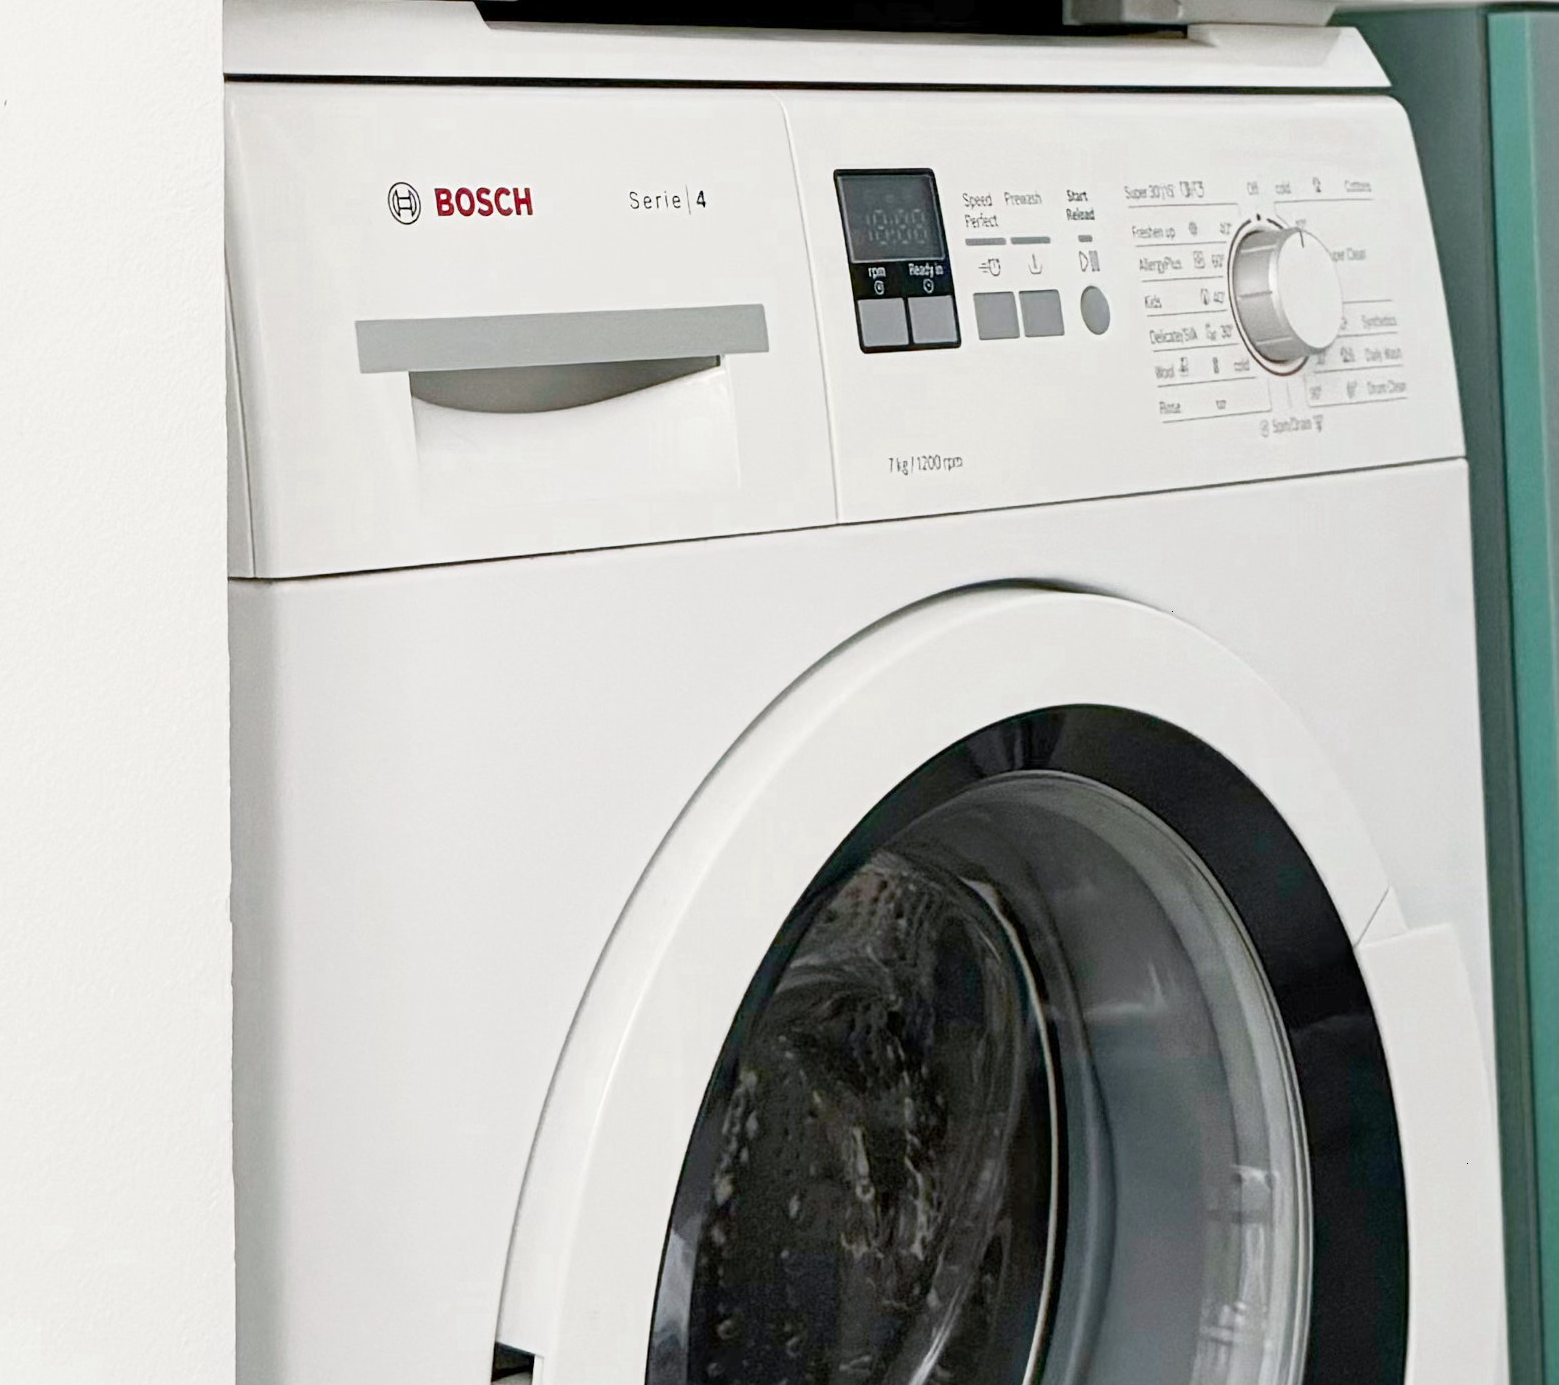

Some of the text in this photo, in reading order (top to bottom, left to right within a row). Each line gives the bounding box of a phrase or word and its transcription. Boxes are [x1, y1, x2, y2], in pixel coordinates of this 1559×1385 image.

[434, 186, 534, 217] BOSCH
[962, 191, 1042, 209] Speed Prewash
[1066, 189, 1088, 202] Start
[964, 213, 999, 228] Perfect
[1066, 207, 1095, 221] Reload
[1132, 225, 1163, 238] Freshen
[1165, 227, 1176, 239] up
[868, 266, 887, 279] rpm
[908, 263, 944, 278] Ready in
[1154, 364, 1175, 379] Wool
[896, 457, 908, 476] kg
[916, 454, 942, 471] 1200
[943, 456, 963, 472] rpm
